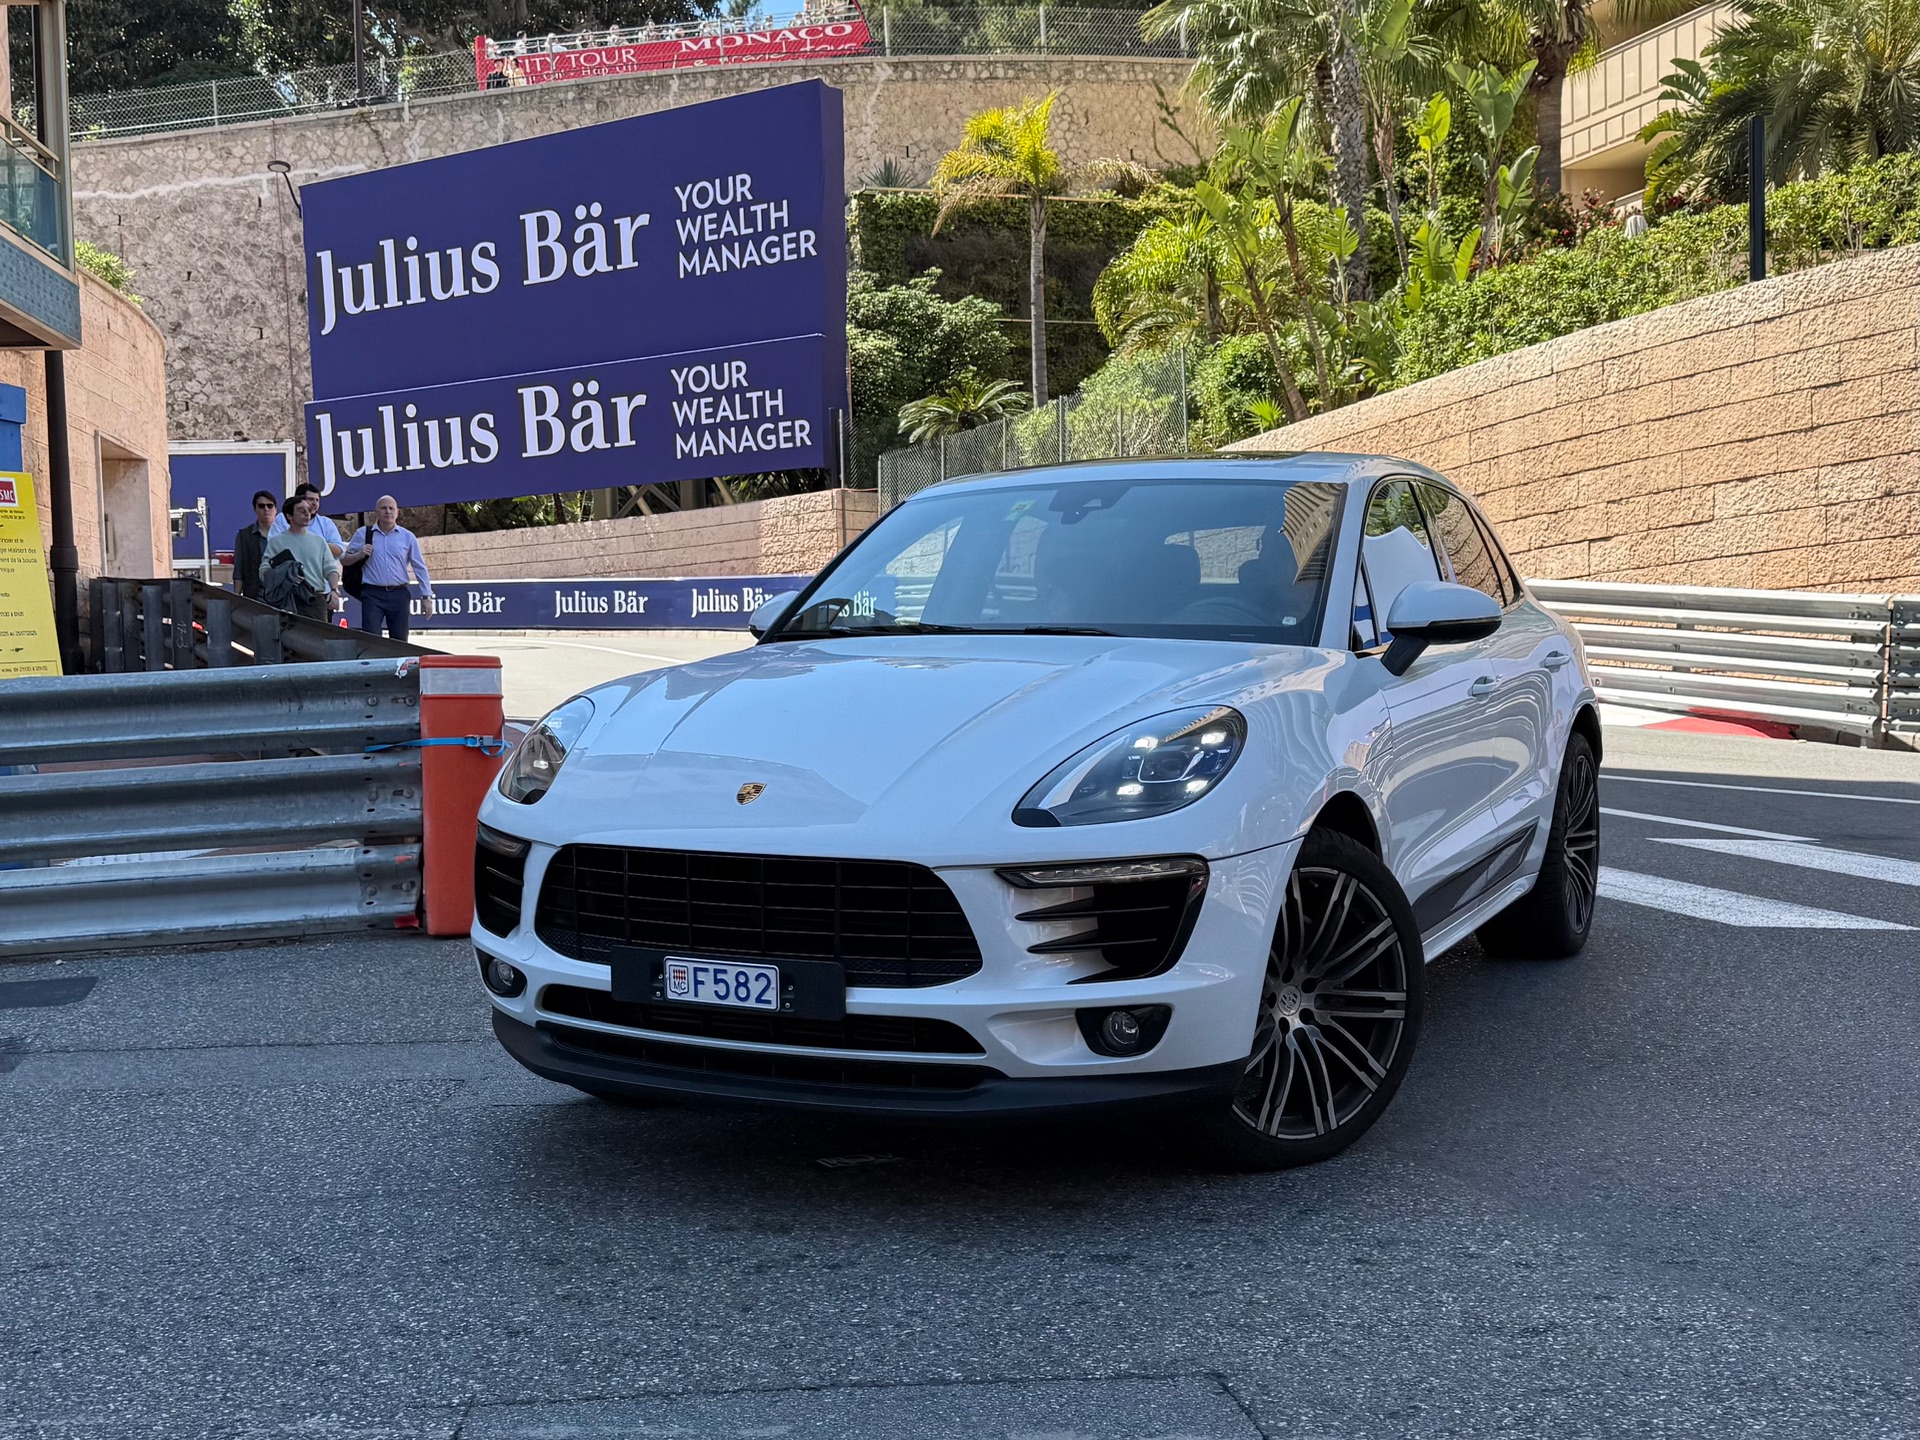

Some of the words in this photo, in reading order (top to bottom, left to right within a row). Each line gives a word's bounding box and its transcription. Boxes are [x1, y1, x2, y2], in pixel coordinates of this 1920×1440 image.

[680, 23, 853, 52] MONACO
[566, 48, 637, 68] TOUR
[674, 173, 753, 212] YOUR
[675, 199, 790, 246] WEALTH
[316, 236, 501, 335] Julius
[519, 201, 651, 286] Bär
[678, 229, 818, 279] MANAGER
[670, 360, 749, 395] YOUR
[672, 388, 785, 428] WEALTH
[315, 403, 499, 497] Julius
[517, 380, 647, 459] Bär
[675, 419, 812, 460] MANAGER
[467, 591, 506, 614] Bär
[554, 590, 609, 618] Julius
[613, 590, 649, 614] Bär
[691, 588, 739, 618] Julius
[852, 590, 877, 618] Bär
[673, 980, 687, 991] MC
[693, 966, 772, 1005] F582
